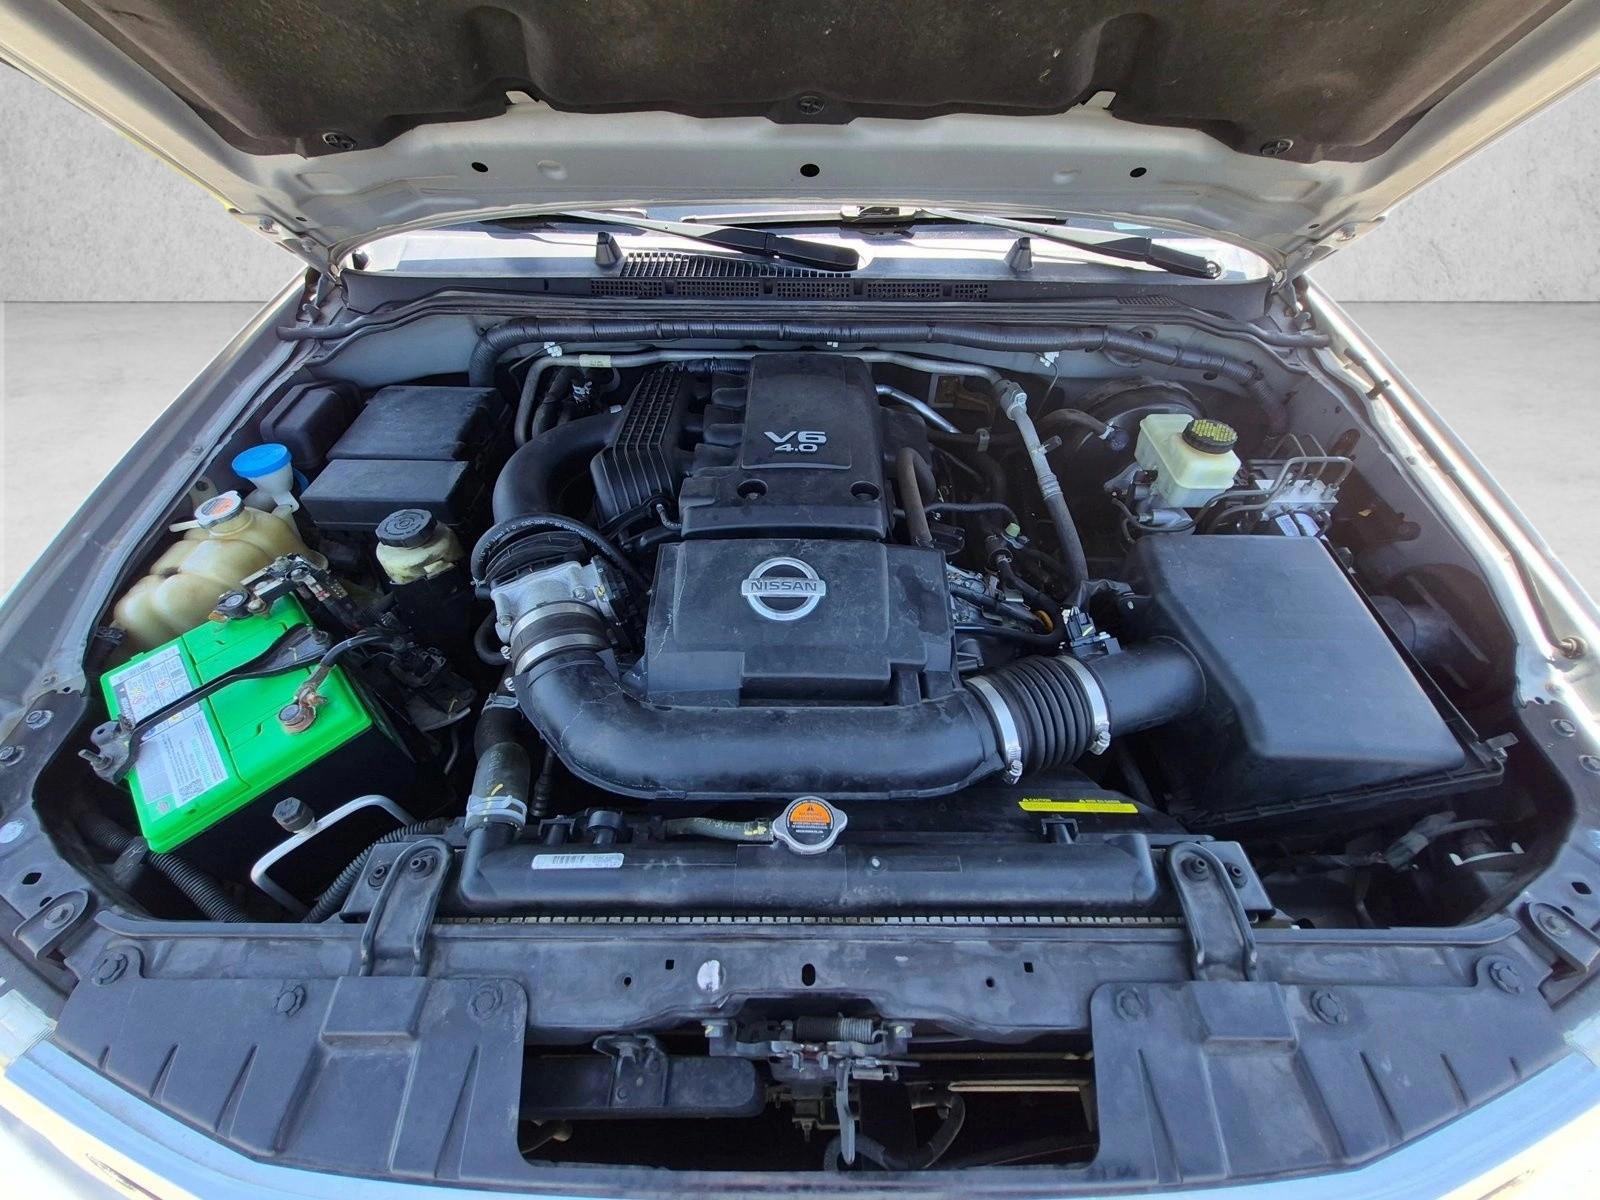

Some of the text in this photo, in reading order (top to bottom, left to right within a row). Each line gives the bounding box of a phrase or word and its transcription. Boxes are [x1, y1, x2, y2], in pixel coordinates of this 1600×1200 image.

[764, 431, 827, 443] V6
[774, 443, 818, 452] 4.0
[751, 581, 817, 591] NISSAN
